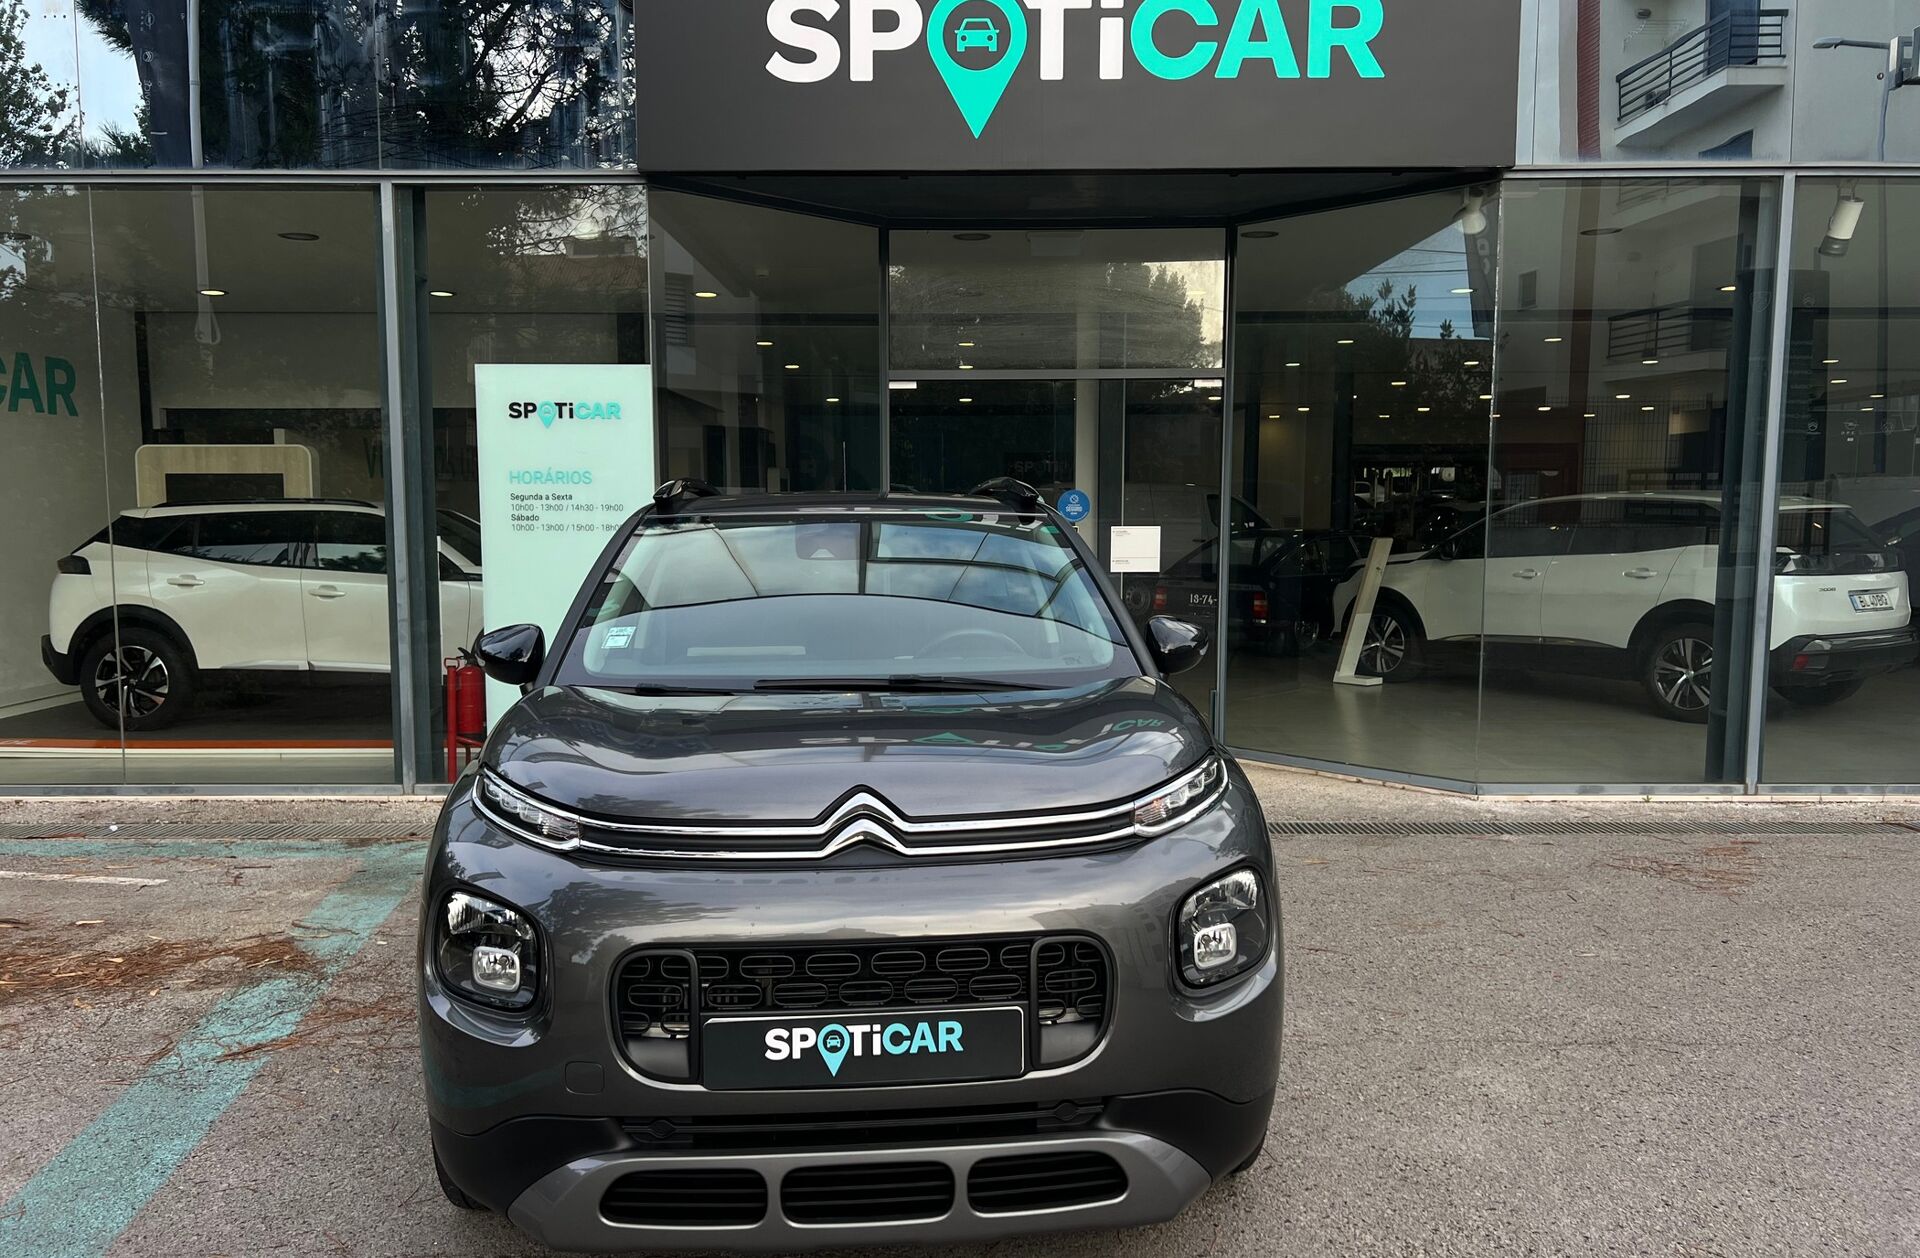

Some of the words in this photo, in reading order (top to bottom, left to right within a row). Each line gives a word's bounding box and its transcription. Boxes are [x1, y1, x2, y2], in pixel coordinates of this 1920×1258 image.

[0, 352, 79, 417] AR
[509, 467, 593, 485] HORÁRIOS
[510, 493, 543, 502] Segunda
[551, 493, 573, 501] Sexta
[511, 503, 535, 512] 10h00
[541, 503, 564, 512] 13h00
[571, 503, 594, 512] 14h30
[601, 503, 624, 512] 19h00
[511, 513, 540, 522] Sábado
[512, 523, 535, 532] 10h00
[542, 523, 565, 532] 13h00
[572, 523, 595, 532] 15h00
[601, 523, 621, 532] 18h0
[764, 1020, 964, 1077] SPOTiCAR
